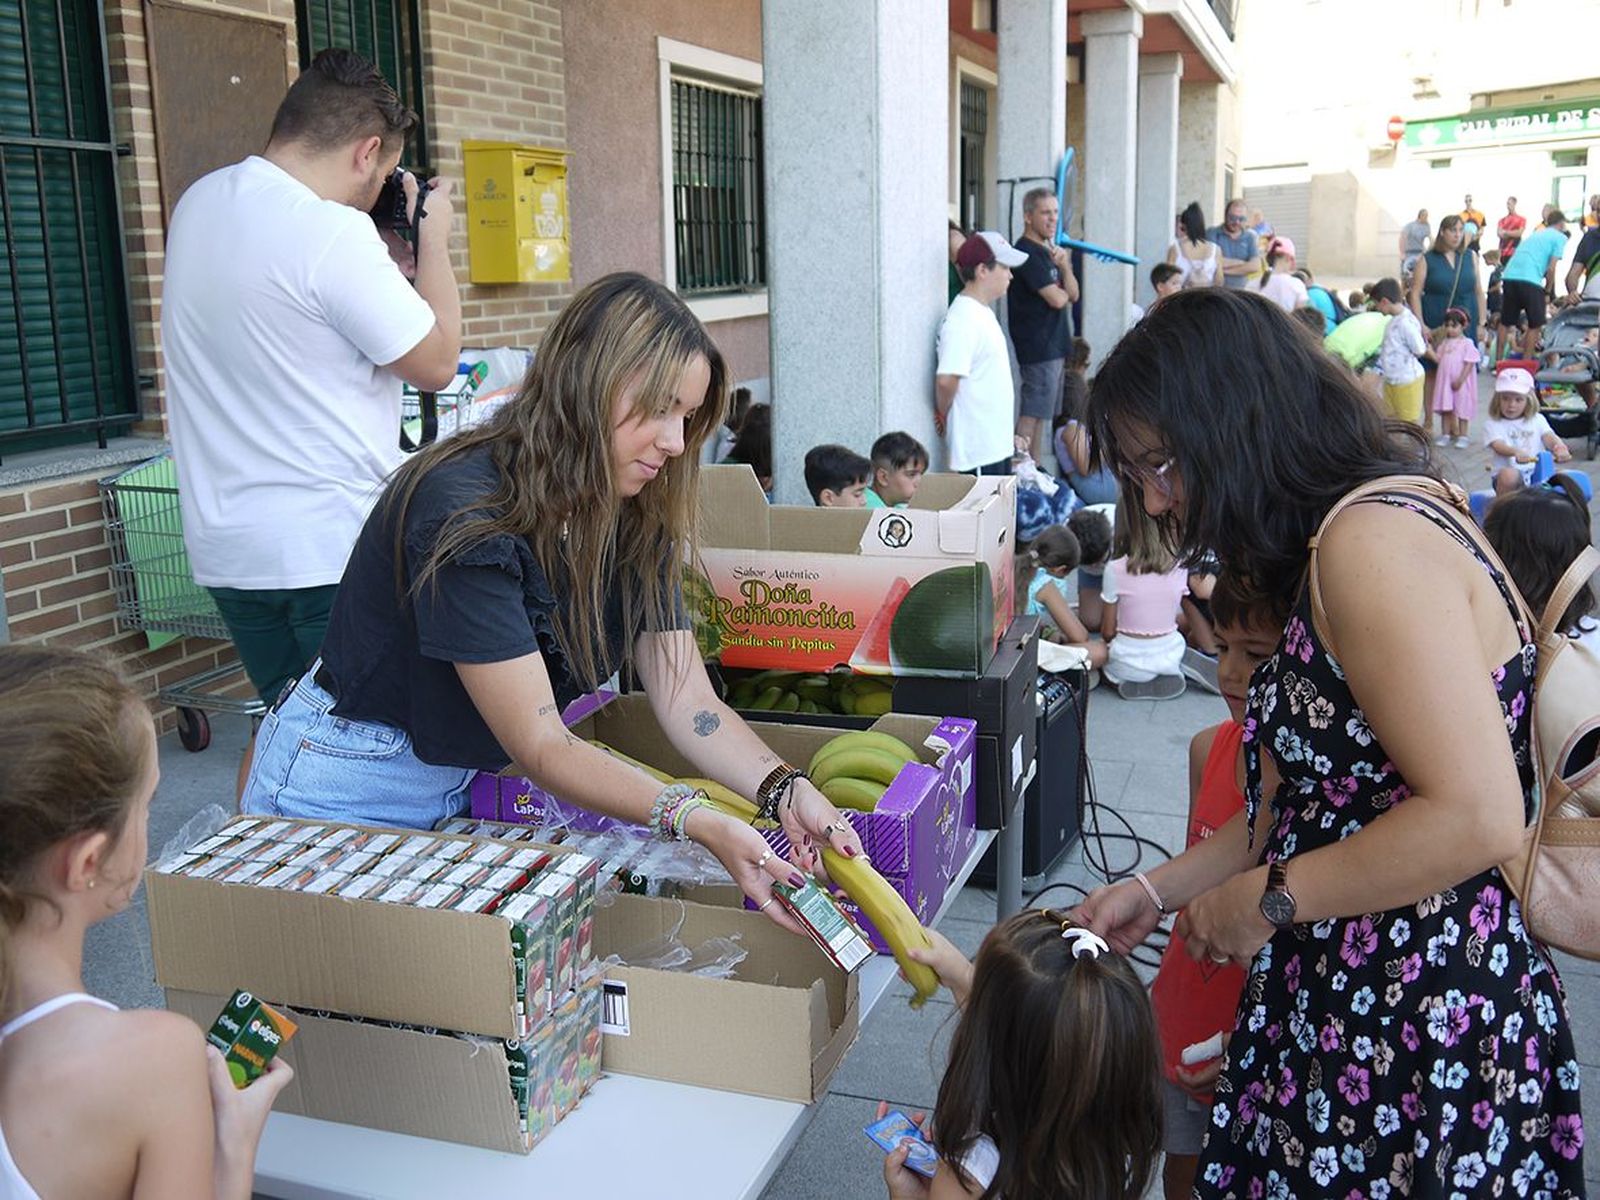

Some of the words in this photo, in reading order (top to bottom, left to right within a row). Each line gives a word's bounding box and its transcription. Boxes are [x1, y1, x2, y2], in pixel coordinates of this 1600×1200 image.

[1556, 109, 1584, 130] DE
[733, 566, 766, 580] Sabor
[769, 568, 820, 581] Auténtico
[739, 579, 813, 608] Doña
[703, 596, 856, 636] Ramoncita
[766, 636, 784, 648] sin
[788, 636, 836, 653] Pepitas
[513, 803, 545, 816] LaPaz
